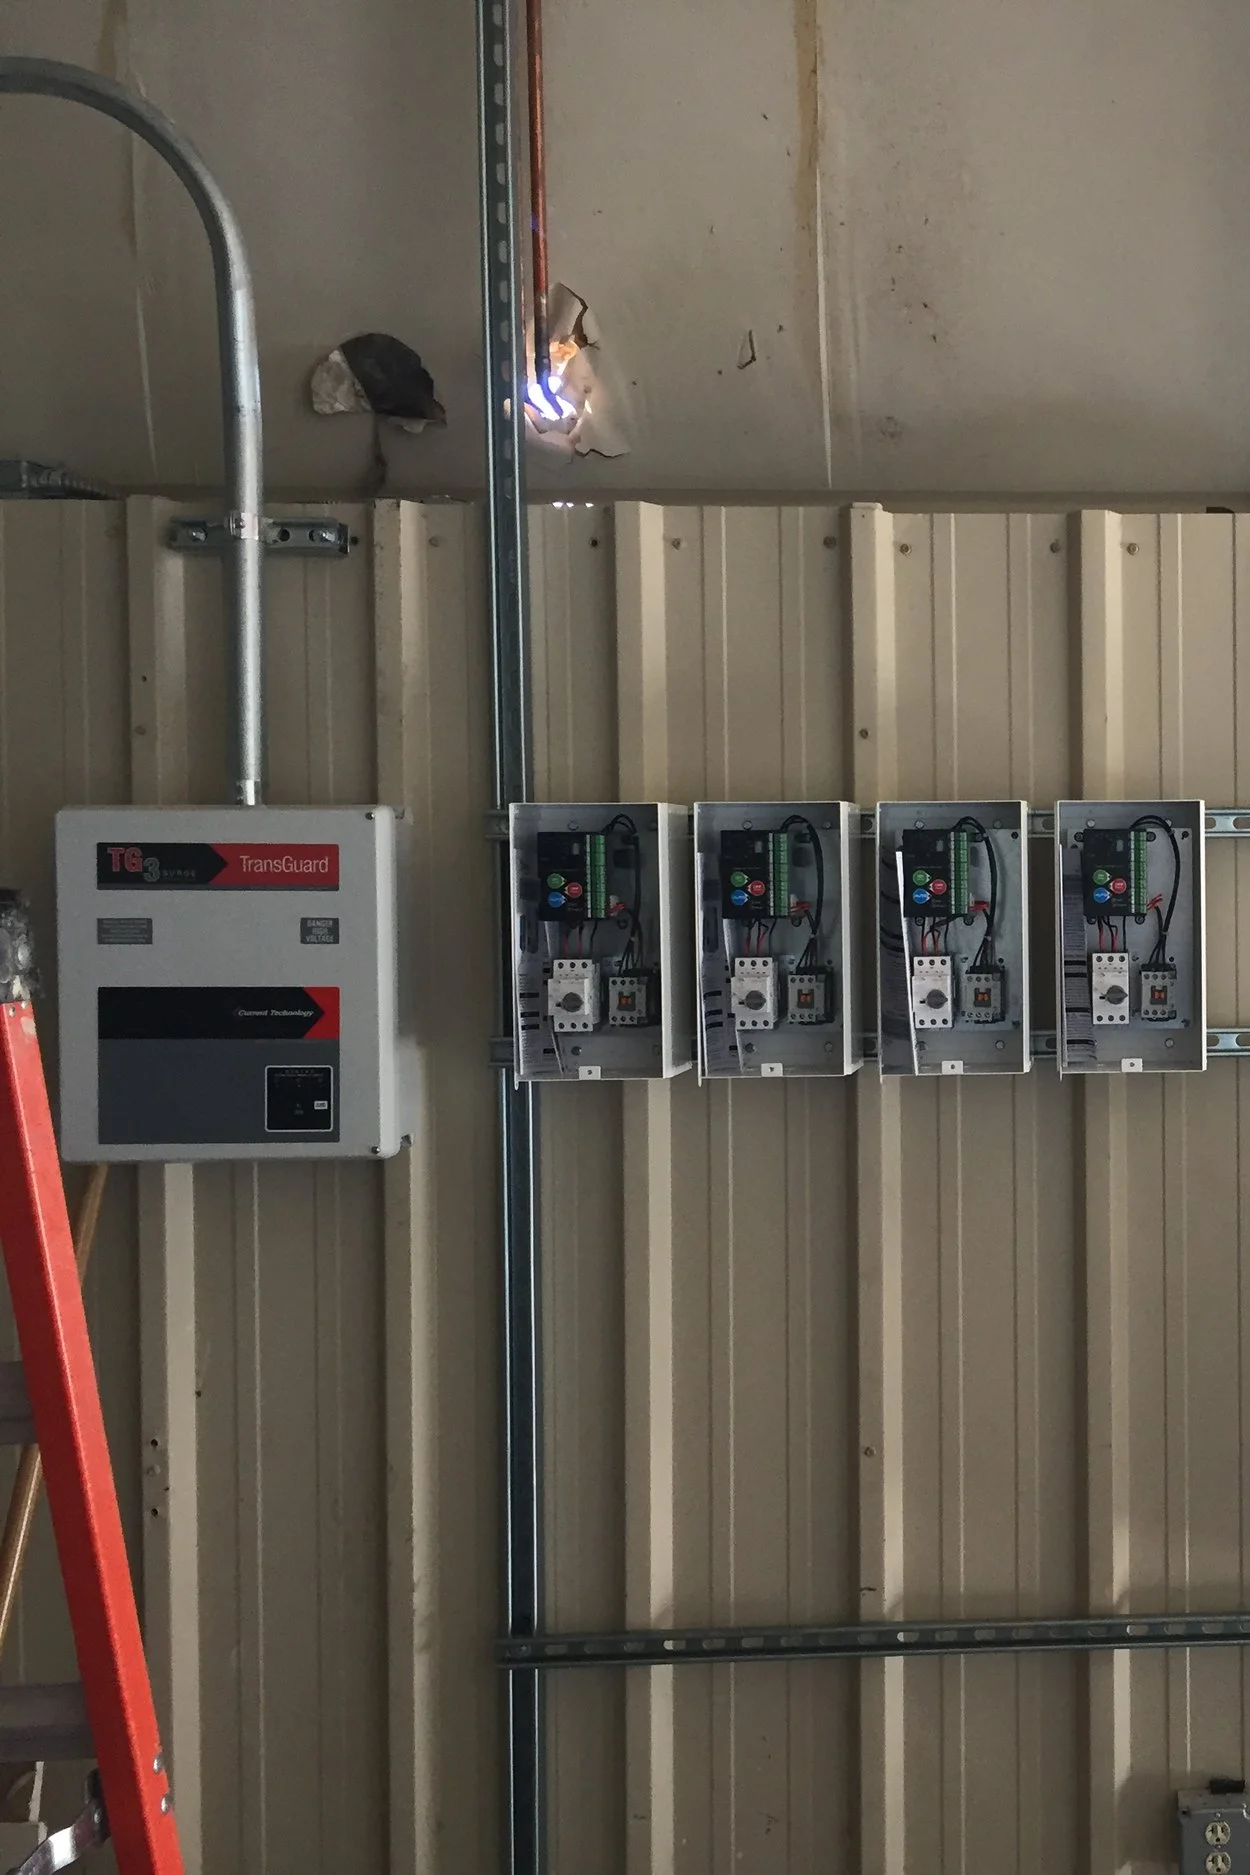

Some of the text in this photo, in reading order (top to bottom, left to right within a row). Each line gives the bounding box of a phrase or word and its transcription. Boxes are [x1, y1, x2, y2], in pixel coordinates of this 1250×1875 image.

[239, 855, 329, 874] TransGuard
[162, 869, 196, 877] SURGE
[306, 919, 333, 928] DANGER
[305, 935, 335, 943] VOLTAGE
[238, 1009, 314, 1018] Current Technology
